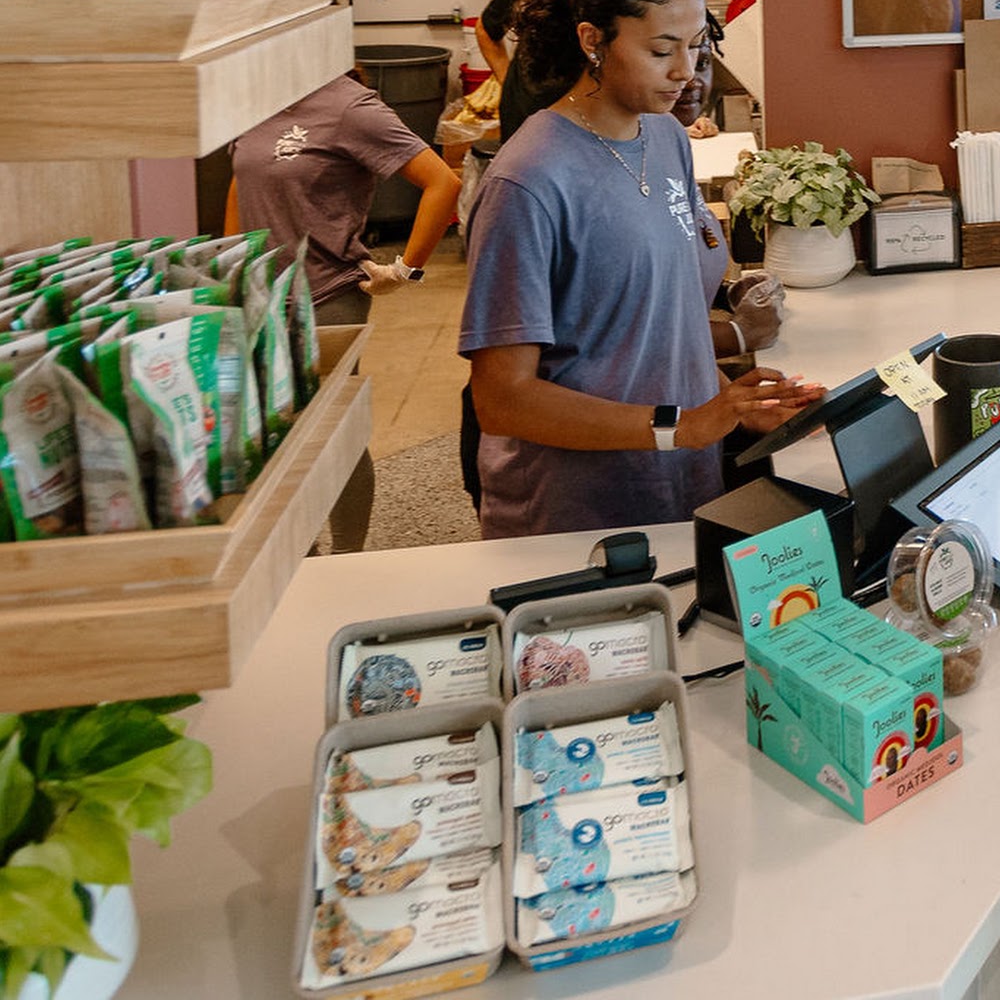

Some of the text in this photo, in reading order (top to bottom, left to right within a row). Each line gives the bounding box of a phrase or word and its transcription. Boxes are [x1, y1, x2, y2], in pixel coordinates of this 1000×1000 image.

[761, 545, 803, 575] Joolies
[588, 635, 647, 657] gomacro
[427, 655, 488, 677] gomacro
[872, 708, 908, 739] Joolies
[596, 725, 659, 748] gomacro
[896, 765, 935, 799] DATES
[604, 807, 670, 831] gomacro
